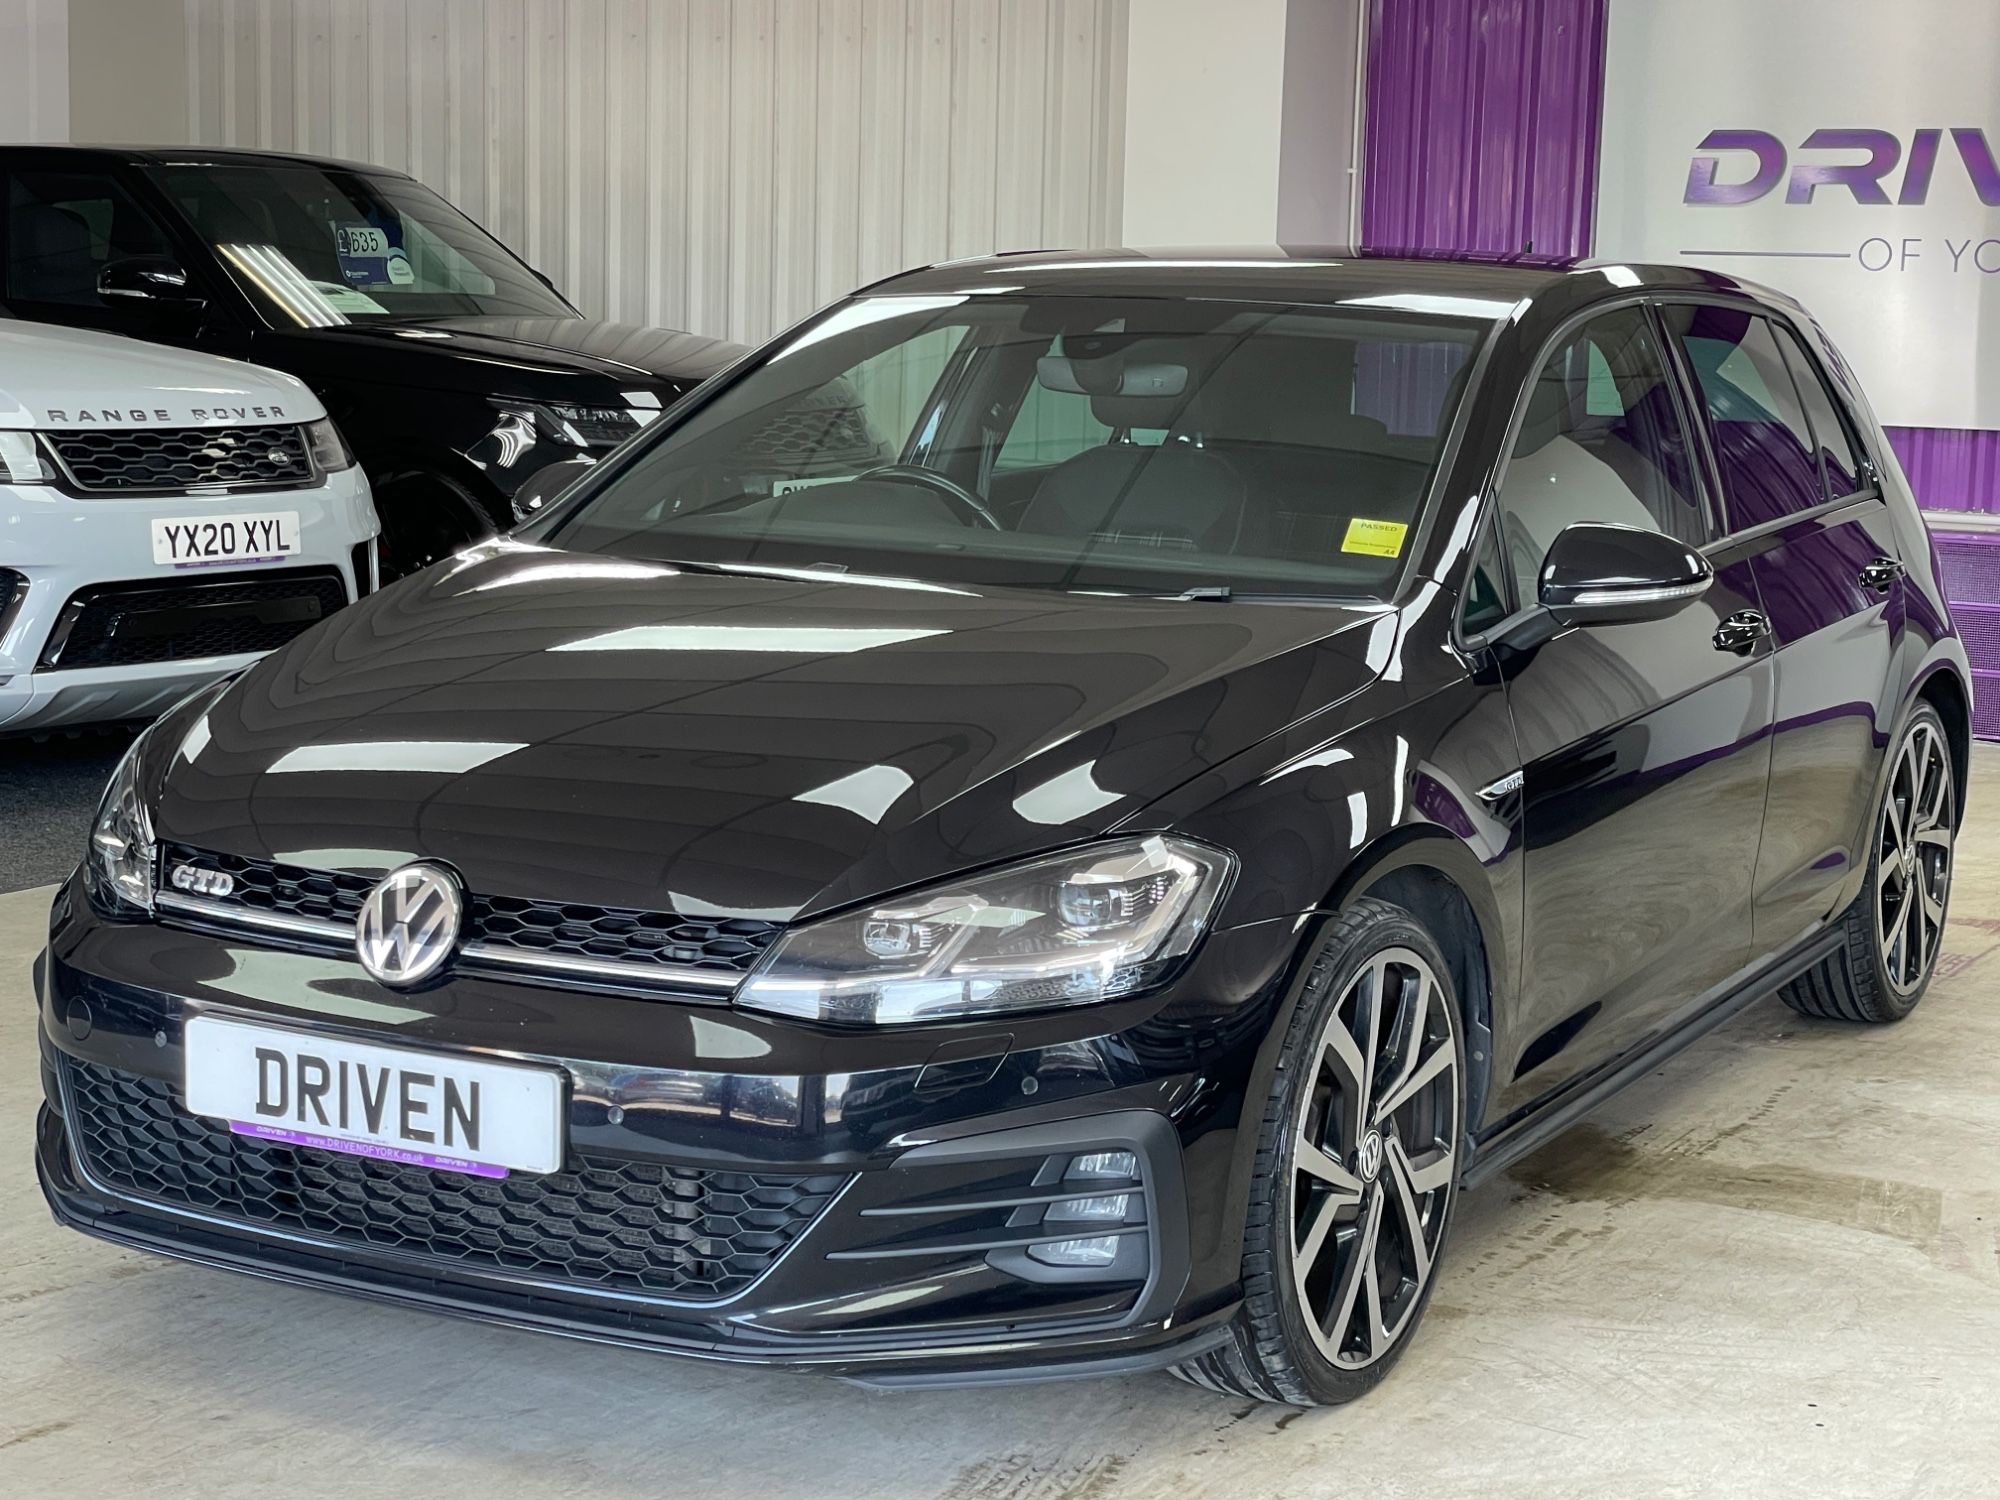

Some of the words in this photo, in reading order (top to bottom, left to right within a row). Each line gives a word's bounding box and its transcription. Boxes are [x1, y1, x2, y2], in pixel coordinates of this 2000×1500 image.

[1859, 238, 1922, 271] OF
[1945, 238, 2000, 273] YO
[48, 409, 171, 422] RANGE
[191, 406, 285, 420] ROVER
[165, 522, 236, 558] YX20
[243, 519, 290, 553] XYL
[1361, 522, 1397, 532] PASSED
[172, 865, 234, 896] GTD
[255, 1047, 480, 1151] DRIVEN
[256, 1126, 287, 1137] DRIVEN
[305, 1136, 424, 1164] www.DRIVENOFYORK.co.uk
[435, 1156, 468, 1169] DRIVEN
